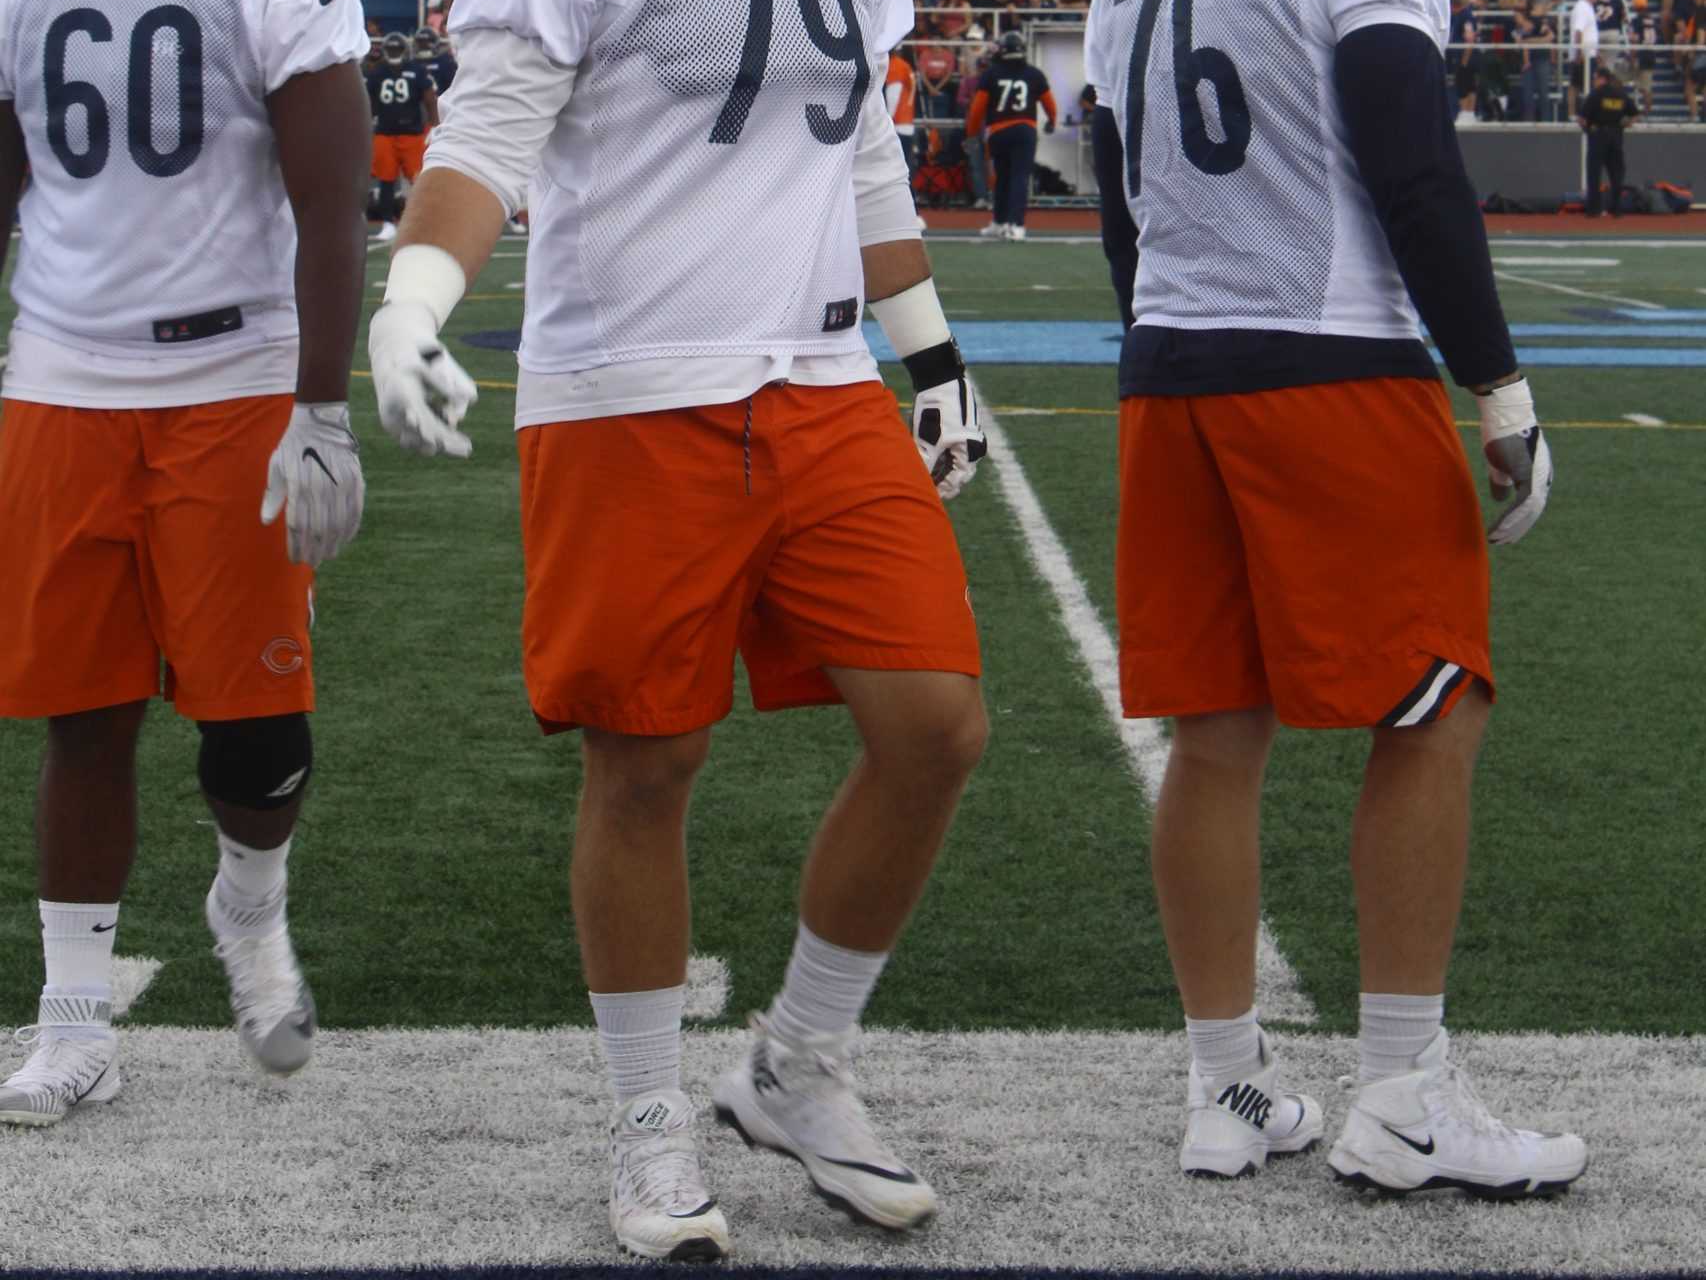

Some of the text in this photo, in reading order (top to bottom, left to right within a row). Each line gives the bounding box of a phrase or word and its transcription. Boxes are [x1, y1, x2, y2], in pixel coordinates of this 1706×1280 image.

[43, 4, 204, 179] 60
[380, 78, 410, 104] 69
[996, 79, 1028, 112] 73
[1217, 1082, 1272, 1130] NIKE
